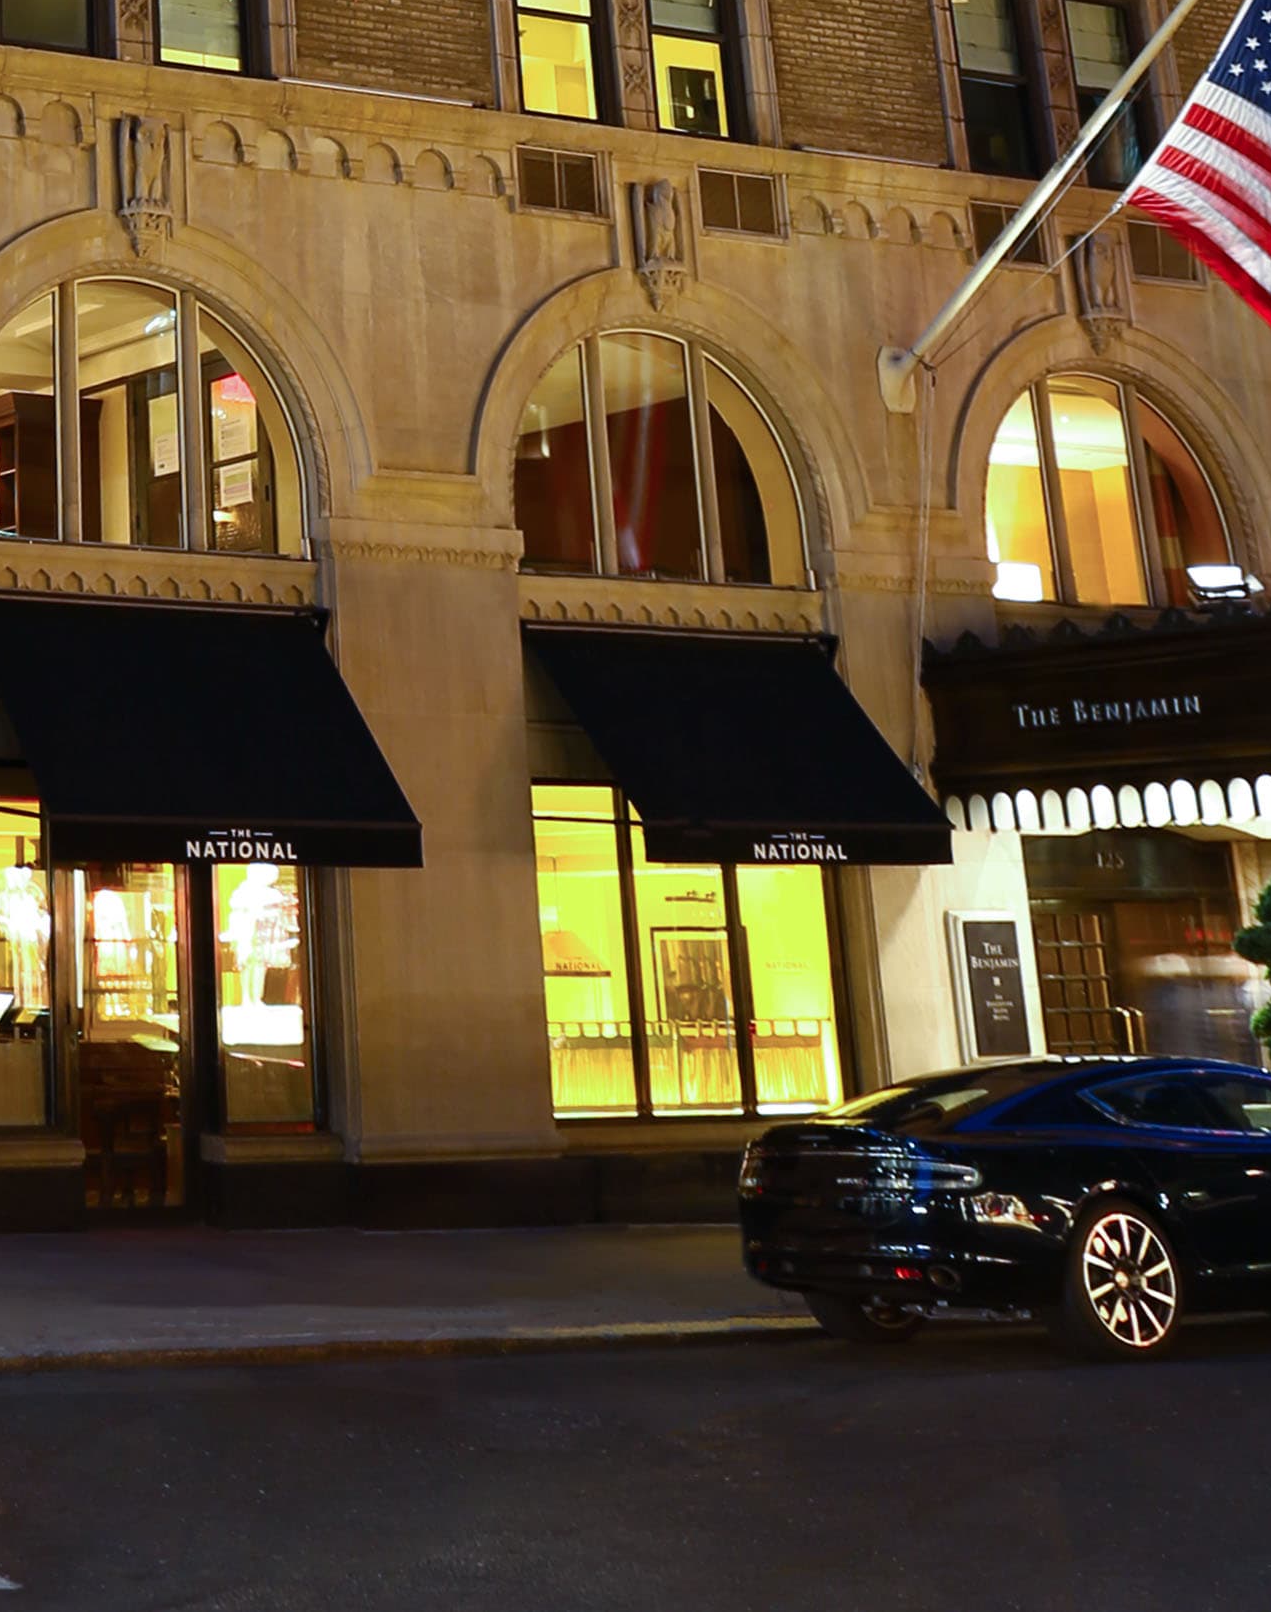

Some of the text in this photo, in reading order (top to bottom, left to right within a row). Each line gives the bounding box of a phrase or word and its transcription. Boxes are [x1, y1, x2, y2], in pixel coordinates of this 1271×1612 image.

[1073, 696, 1201, 723] BENJAMIN
[230, 828, 251, 838] THE
[789, 832, 808, 841] THE
[186, 840, 298, 860] NATIONAL
[753, 843, 848, 860] NATIONAL
[982, 942, 1003, 955] THE
[970, 953, 1019, 970] BENJAMIN
